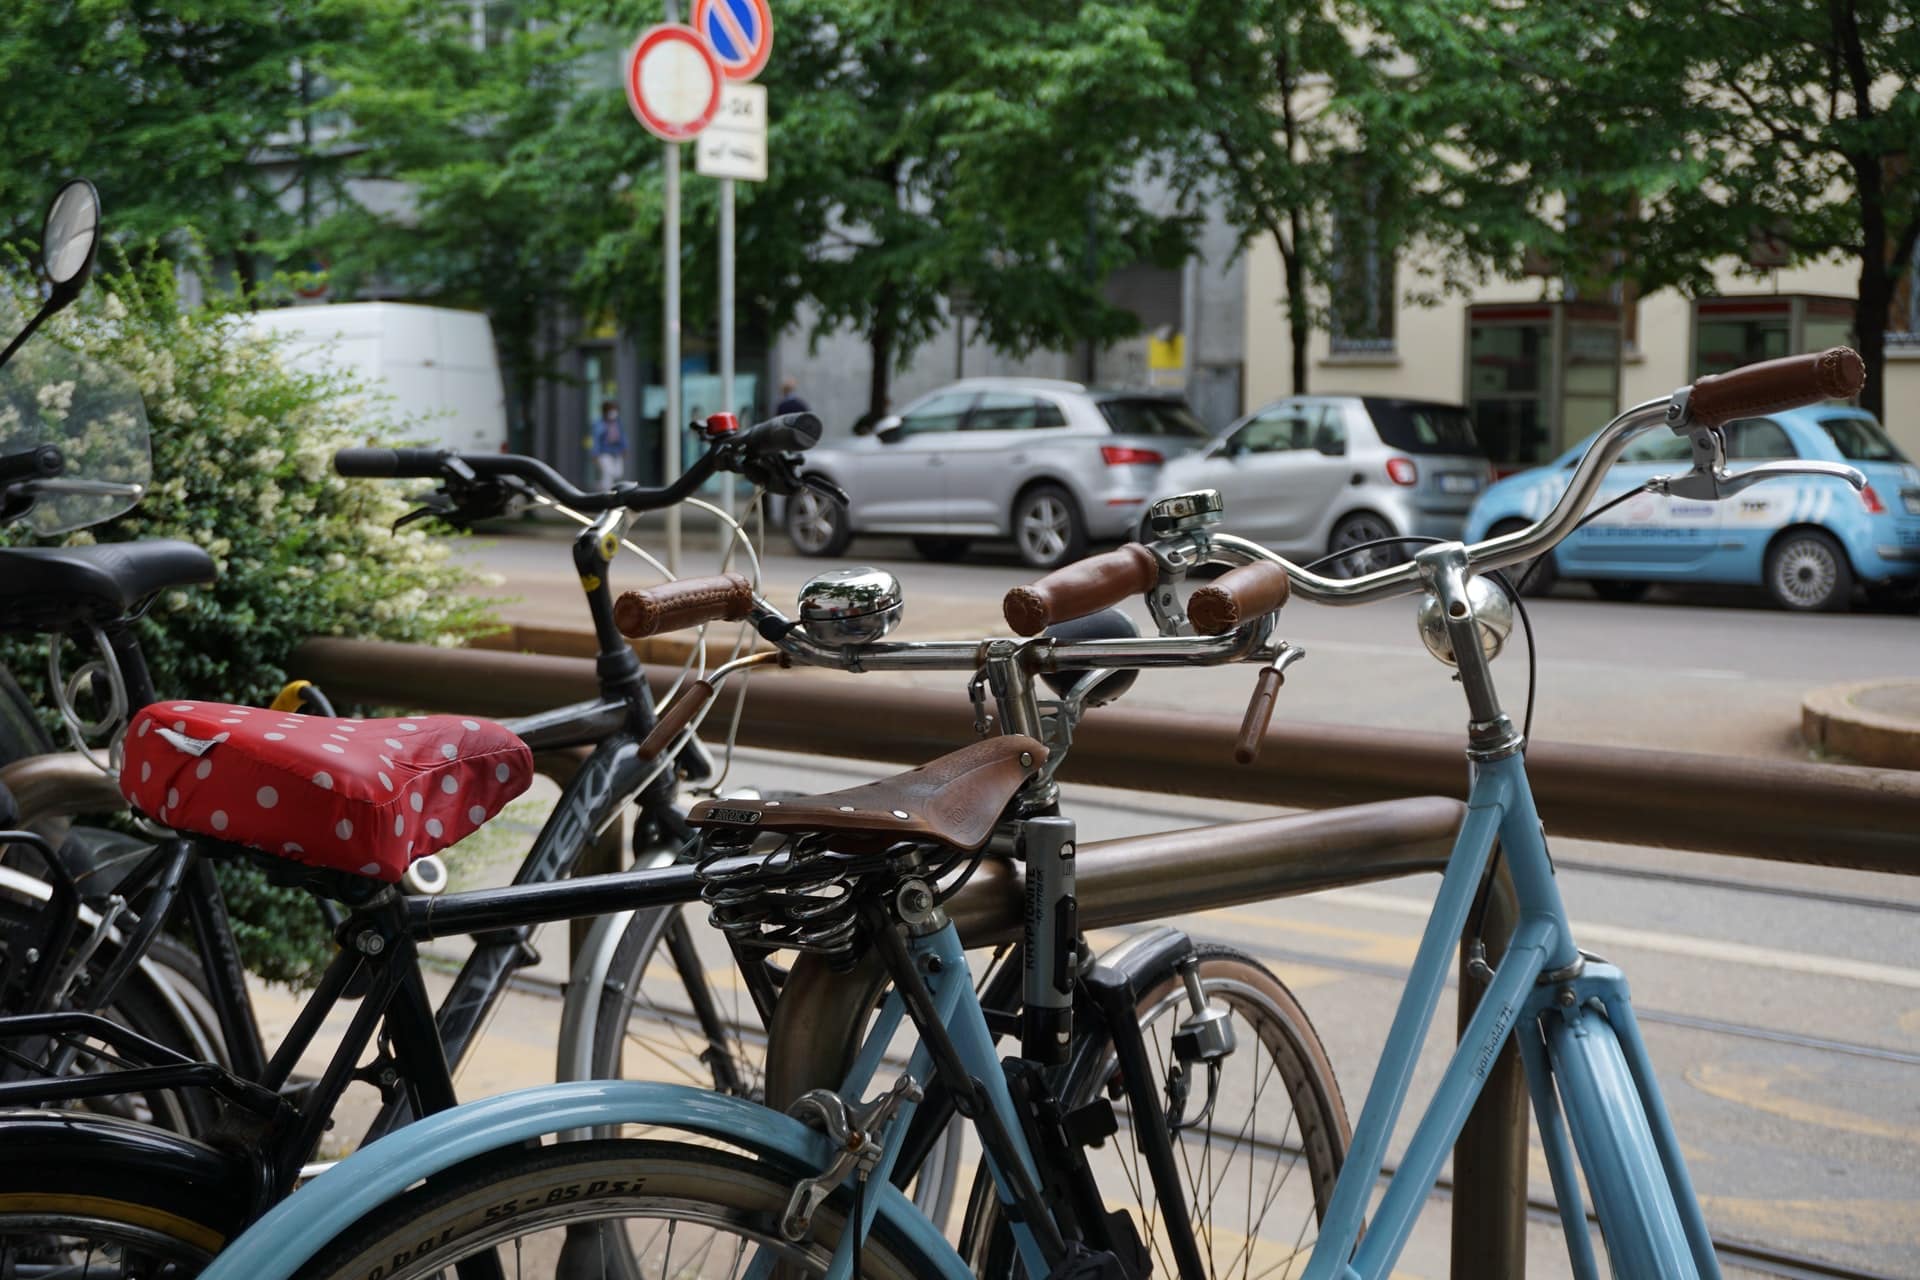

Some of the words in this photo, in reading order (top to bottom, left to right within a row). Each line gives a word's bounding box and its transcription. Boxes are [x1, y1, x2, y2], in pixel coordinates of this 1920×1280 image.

[1024, 867, 1036, 970] KRYPTONITE
[1475, 1020, 1506, 1080] garibaldi
[391, 1226, 457, 1271] bar
